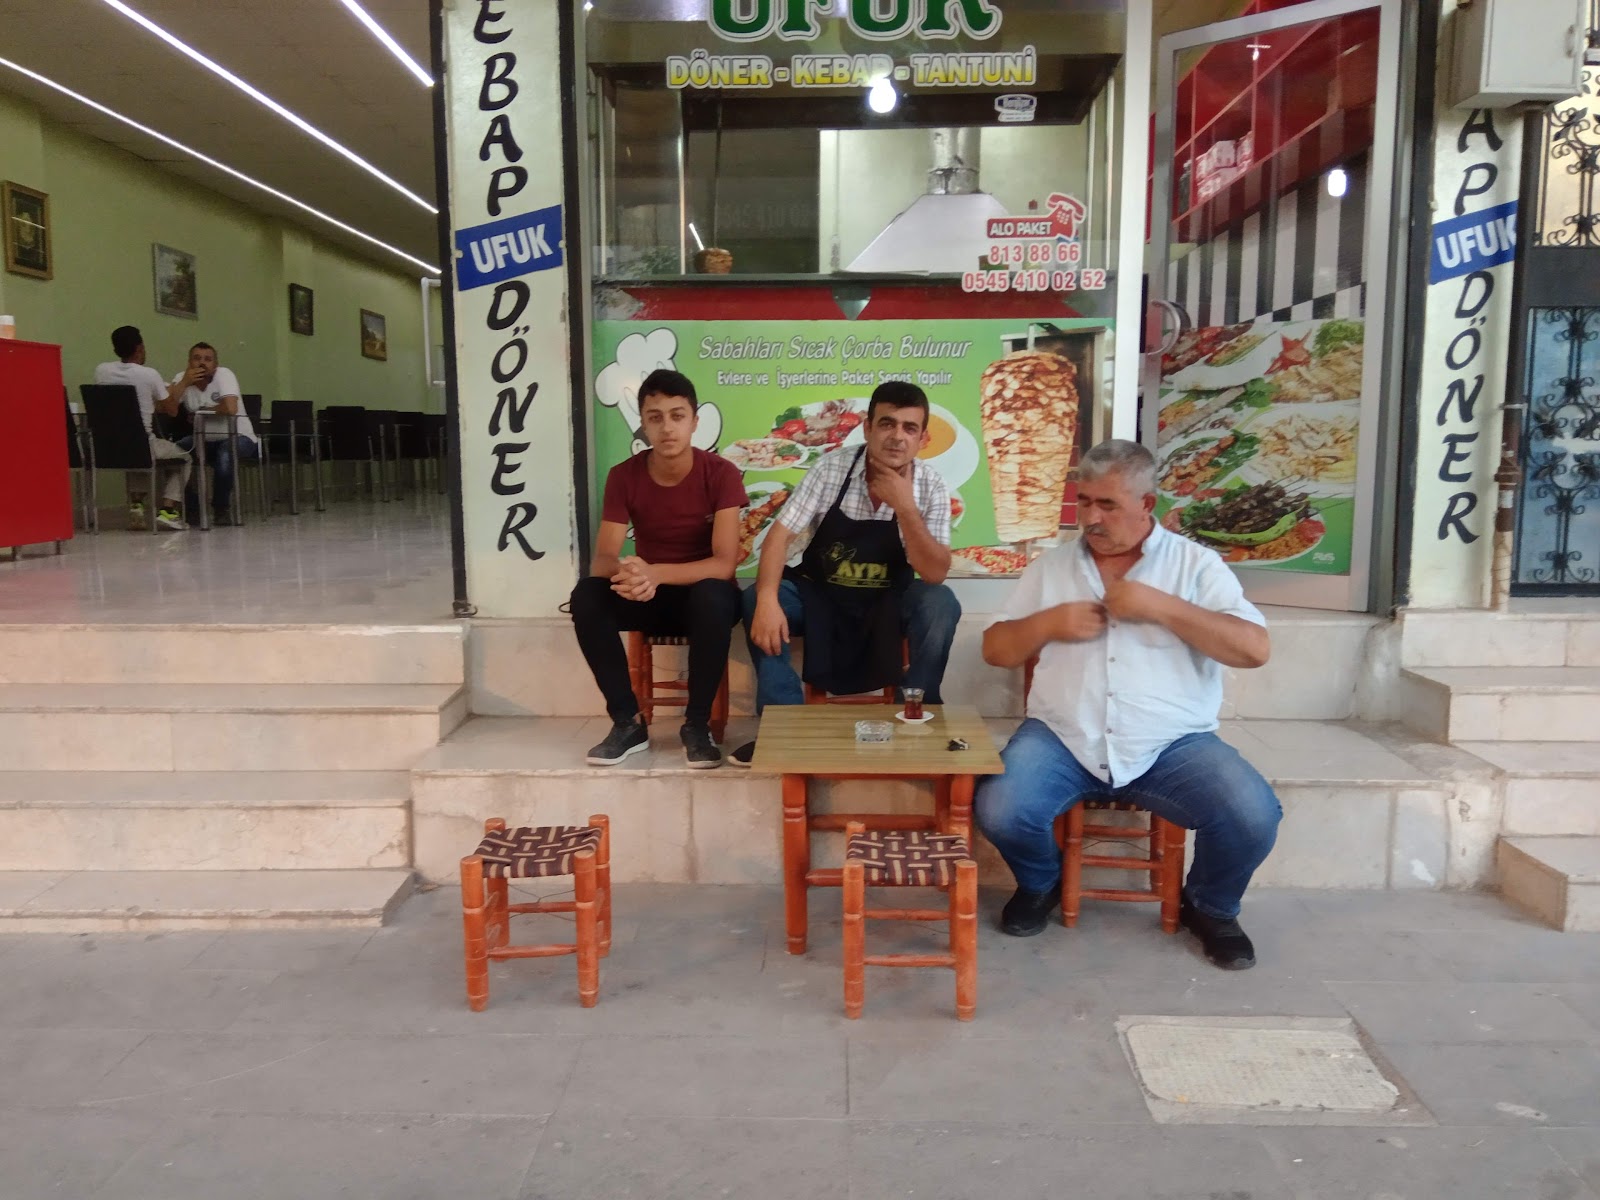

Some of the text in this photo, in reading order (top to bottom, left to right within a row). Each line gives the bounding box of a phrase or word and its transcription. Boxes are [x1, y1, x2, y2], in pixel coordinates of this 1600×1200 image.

[668, 50, 772, 88] DÖNER
[792, 54, 893, 88] KEBAP
[911, 45, 1036, 86] TANTUNİ
[989, 221, 1053, 236] ALO PAKET
[1435, 213, 1517, 268] UFUK
[469, 223, 553, 274] UFUK
[988, 242, 1081, 264] 813 88 66
[962, 269, 1106, 292] 0545 410 02 52
[699, 334, 972, 365] Sabahları Sıcak Çorba Bulunur
[717, 369, 752, 385] Evlere
[755, 373, 769, 385] ve
[841, 369, 874, 385] Paket
[878, 369, 912, 384] Servis
[916, 369, 952, 389] Yapılır
[486, 279, 546, 561] DÖNER
[1436, 270, 1495, 544] DÖNER
